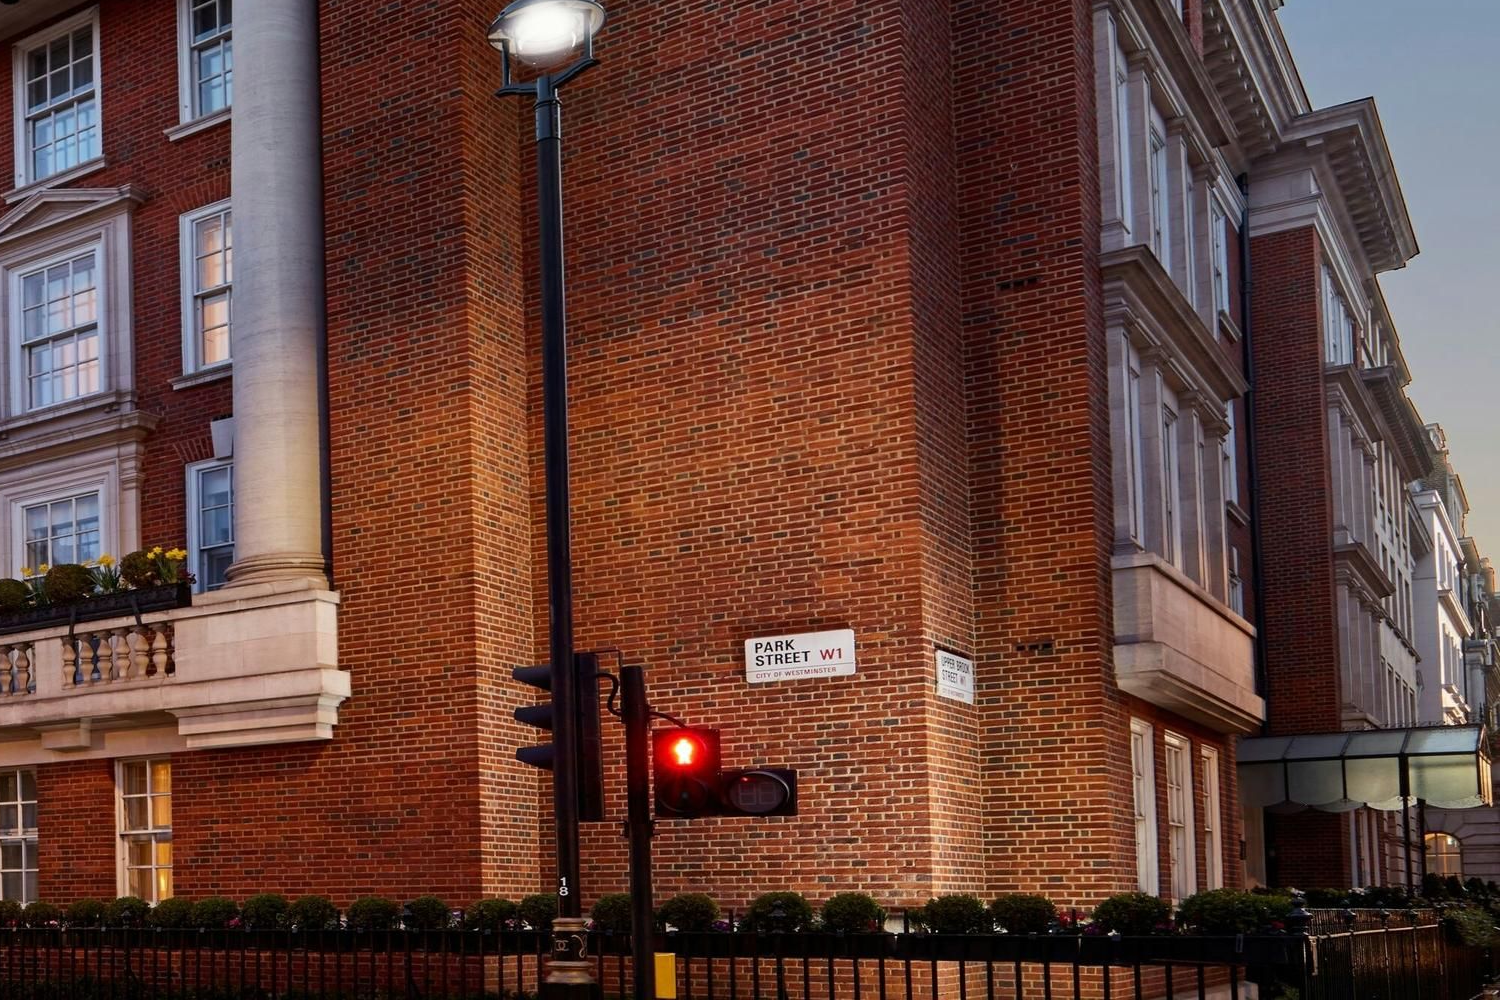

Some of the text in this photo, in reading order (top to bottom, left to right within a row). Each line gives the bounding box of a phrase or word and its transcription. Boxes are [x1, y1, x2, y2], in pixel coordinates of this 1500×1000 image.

[755, 639, 795, 653] PARK
[755, 648, 842, 666] STREET W1
[785, 667, 837, 676] WESTMINSTER
[941, 656, 970, 674] UPPER BROOK
[942, 669, 958, 684] STREET
